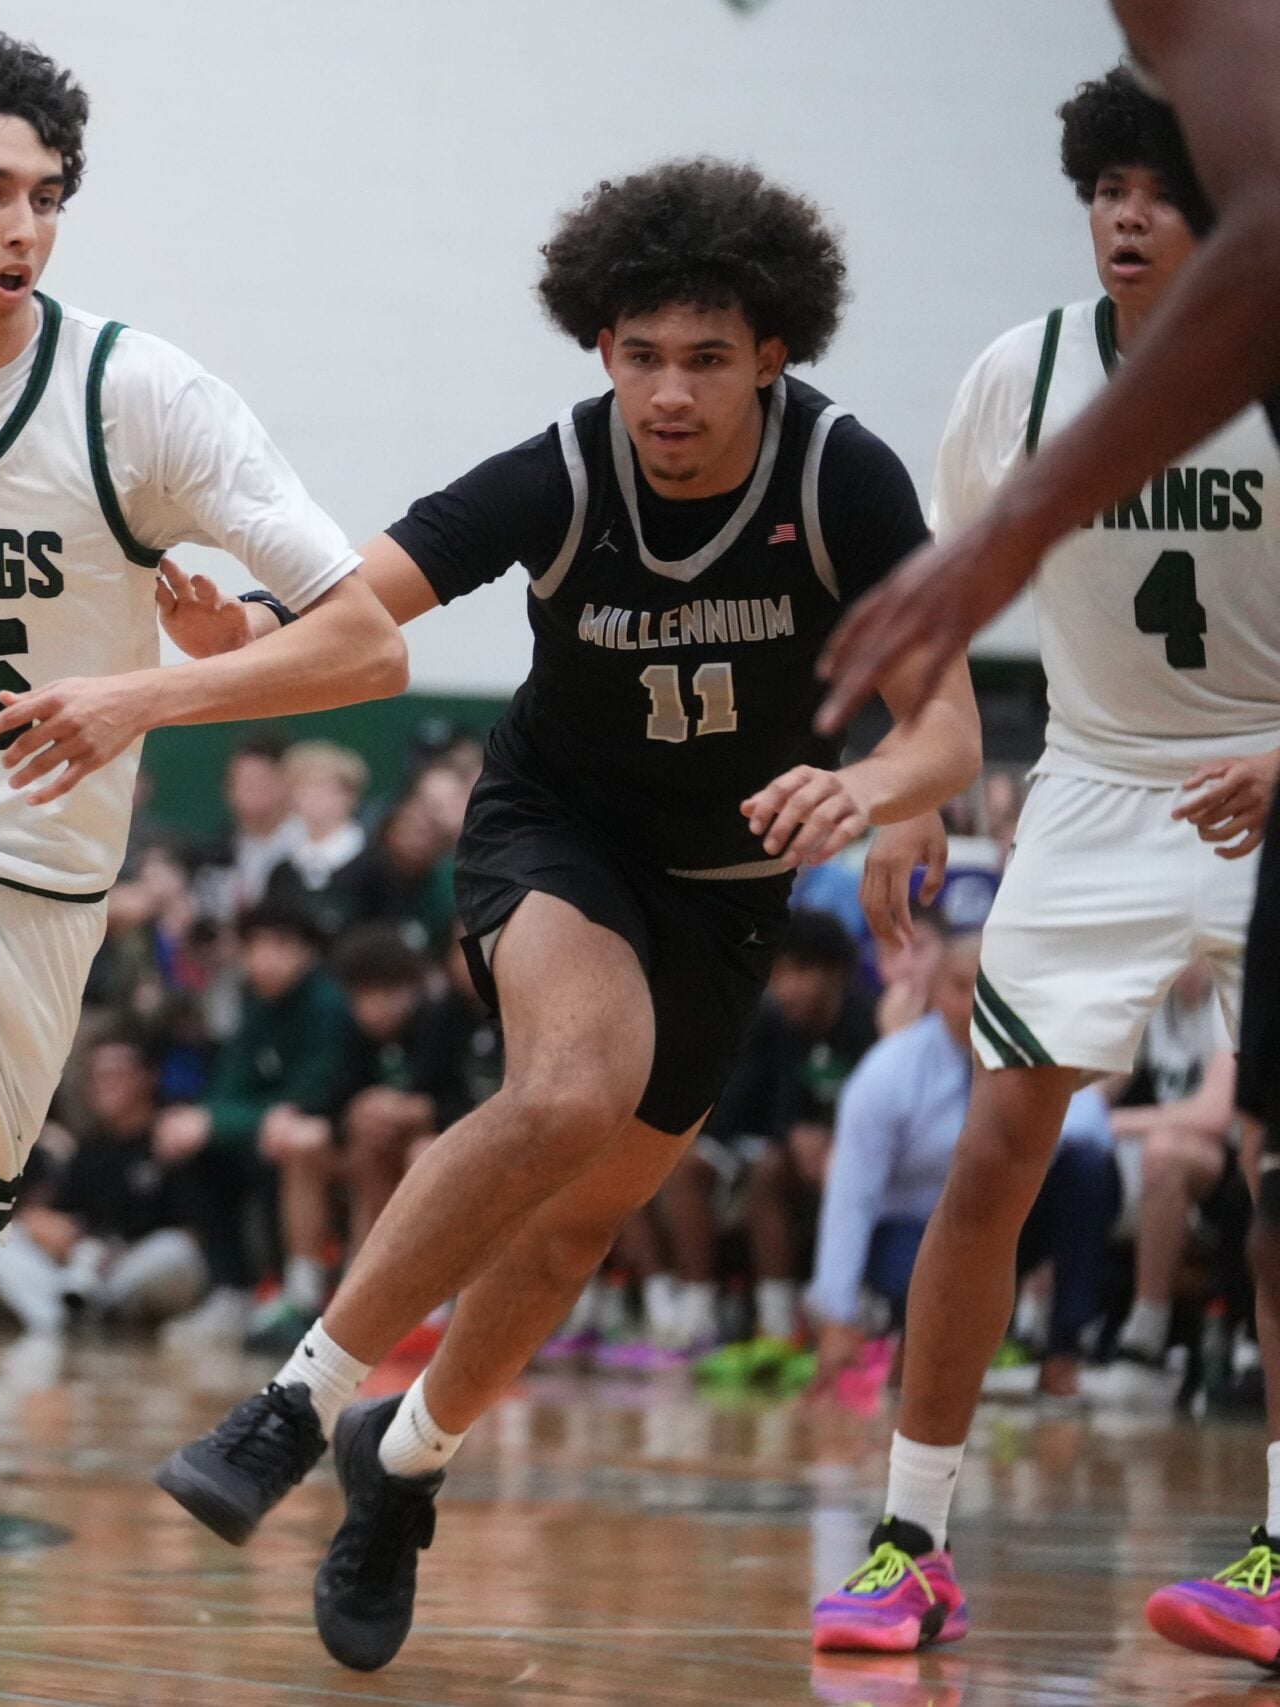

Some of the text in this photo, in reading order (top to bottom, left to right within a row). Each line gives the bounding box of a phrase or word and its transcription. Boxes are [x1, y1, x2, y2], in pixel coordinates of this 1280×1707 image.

[578, 595, 795, 650] MILLENNIUM
[1133, 549, 1207, 669] 4
[639, 662, 738, 743] 11
